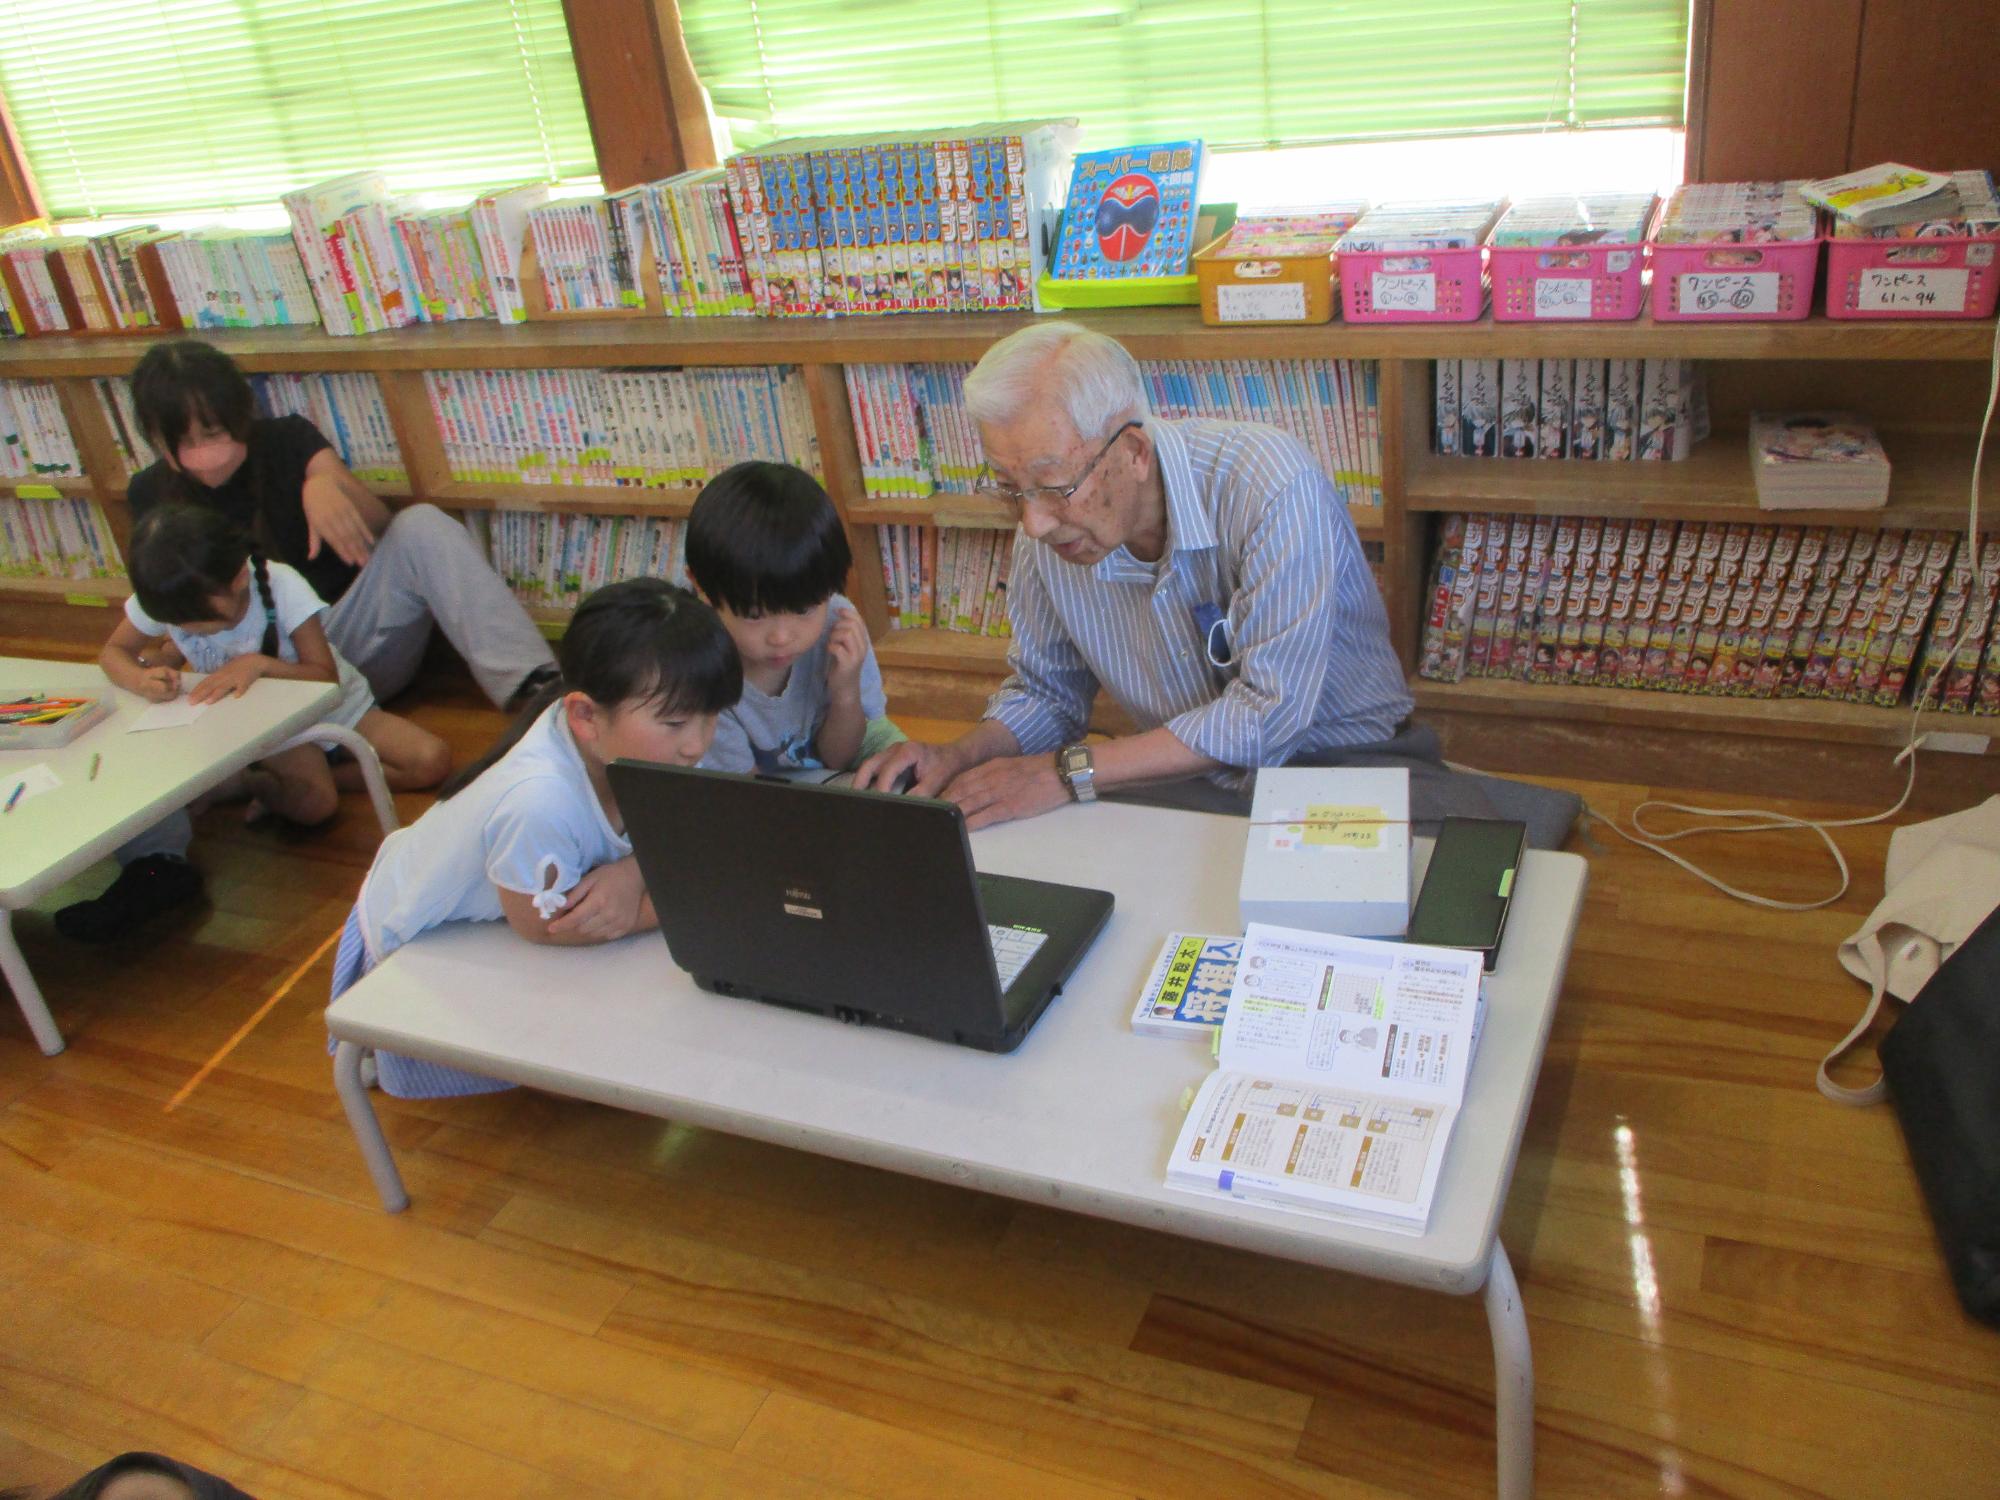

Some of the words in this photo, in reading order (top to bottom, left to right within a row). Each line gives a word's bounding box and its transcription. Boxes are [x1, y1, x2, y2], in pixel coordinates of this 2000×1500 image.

[1688, 276, 1755, 291] ワンピース
[1871, 273, 1927, 287] ワンピース
